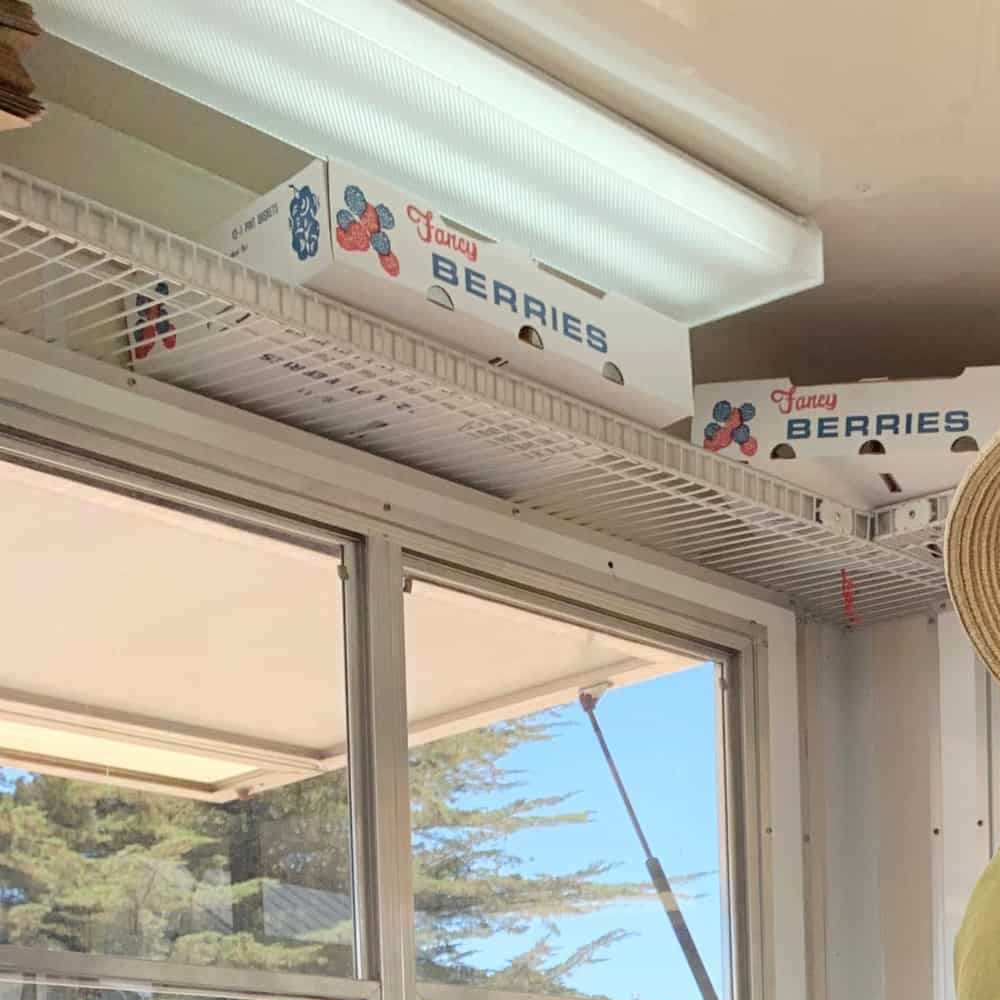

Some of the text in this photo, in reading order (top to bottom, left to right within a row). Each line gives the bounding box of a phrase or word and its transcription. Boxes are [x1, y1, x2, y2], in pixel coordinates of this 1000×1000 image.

[406, 204, 478, 262] Fancy
[431, 253, 608, 354] BERRIES
[770, 384, 838, 414] Fancy
[787, 410, 969, 440] BERRIES
